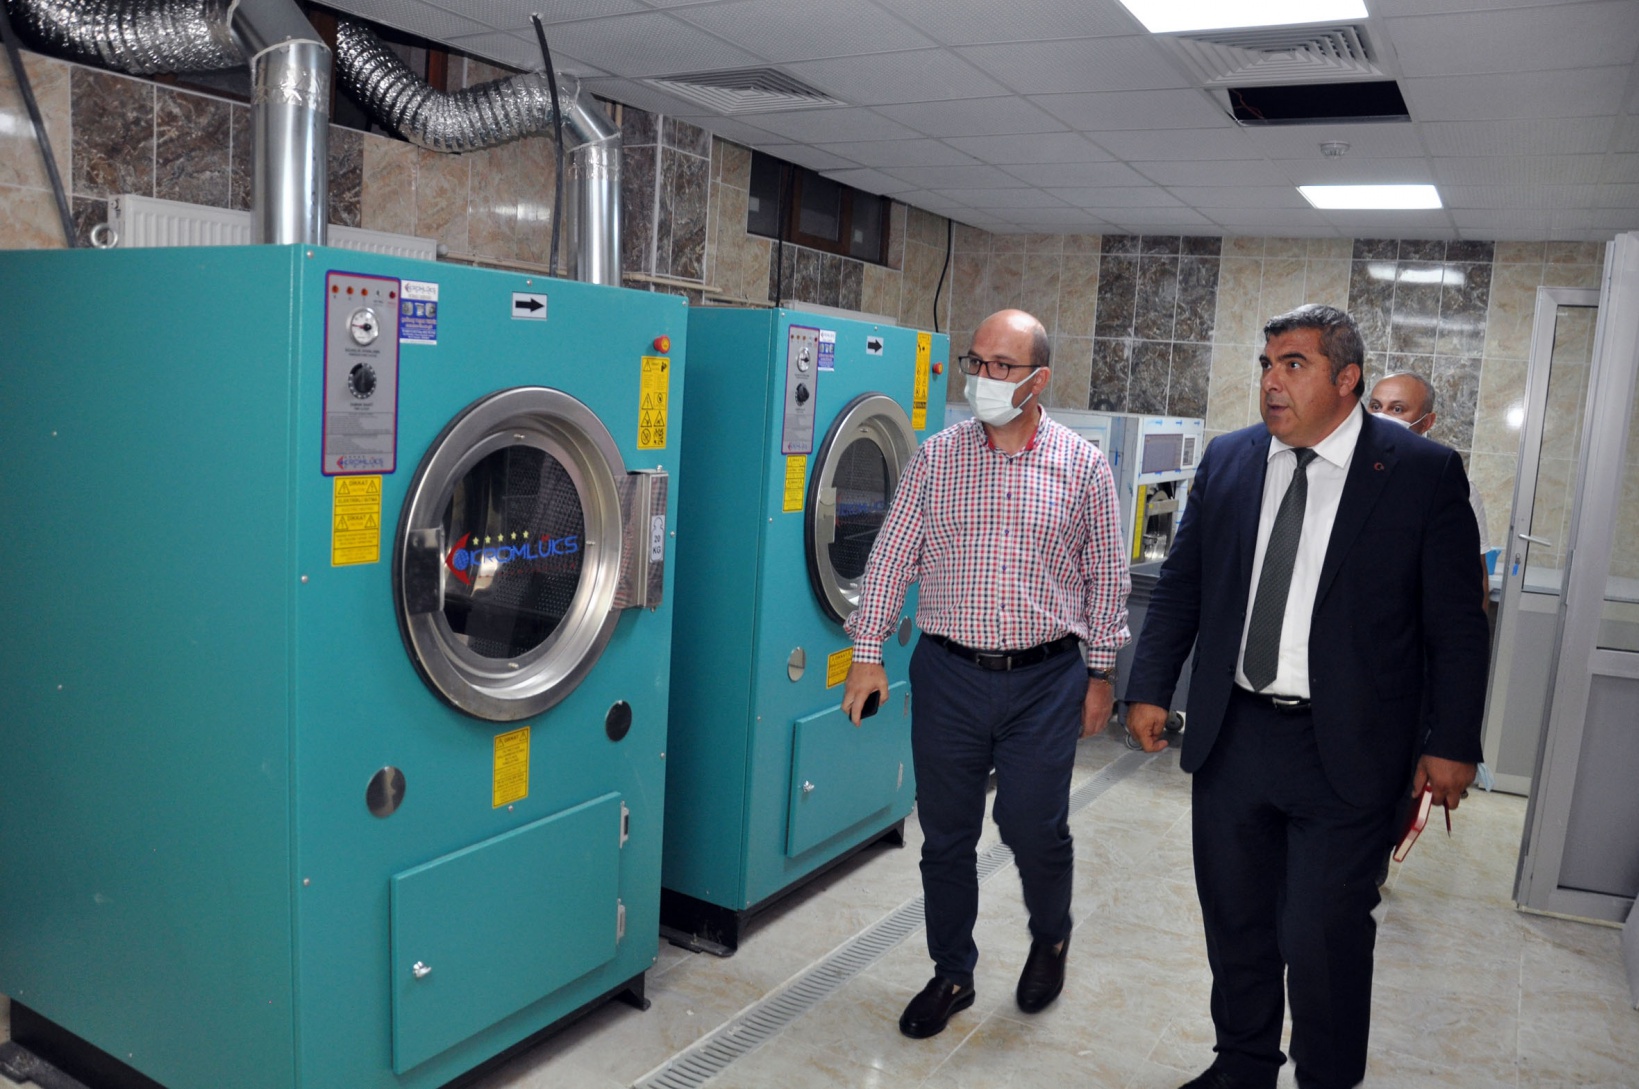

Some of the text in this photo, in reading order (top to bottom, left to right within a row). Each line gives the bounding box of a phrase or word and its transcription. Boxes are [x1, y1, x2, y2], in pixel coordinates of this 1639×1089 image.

[654, 535, 661, 543] 20
[470, 534, 579, 567] KROMLÜKS
[652, 546, 662, 554] KG
